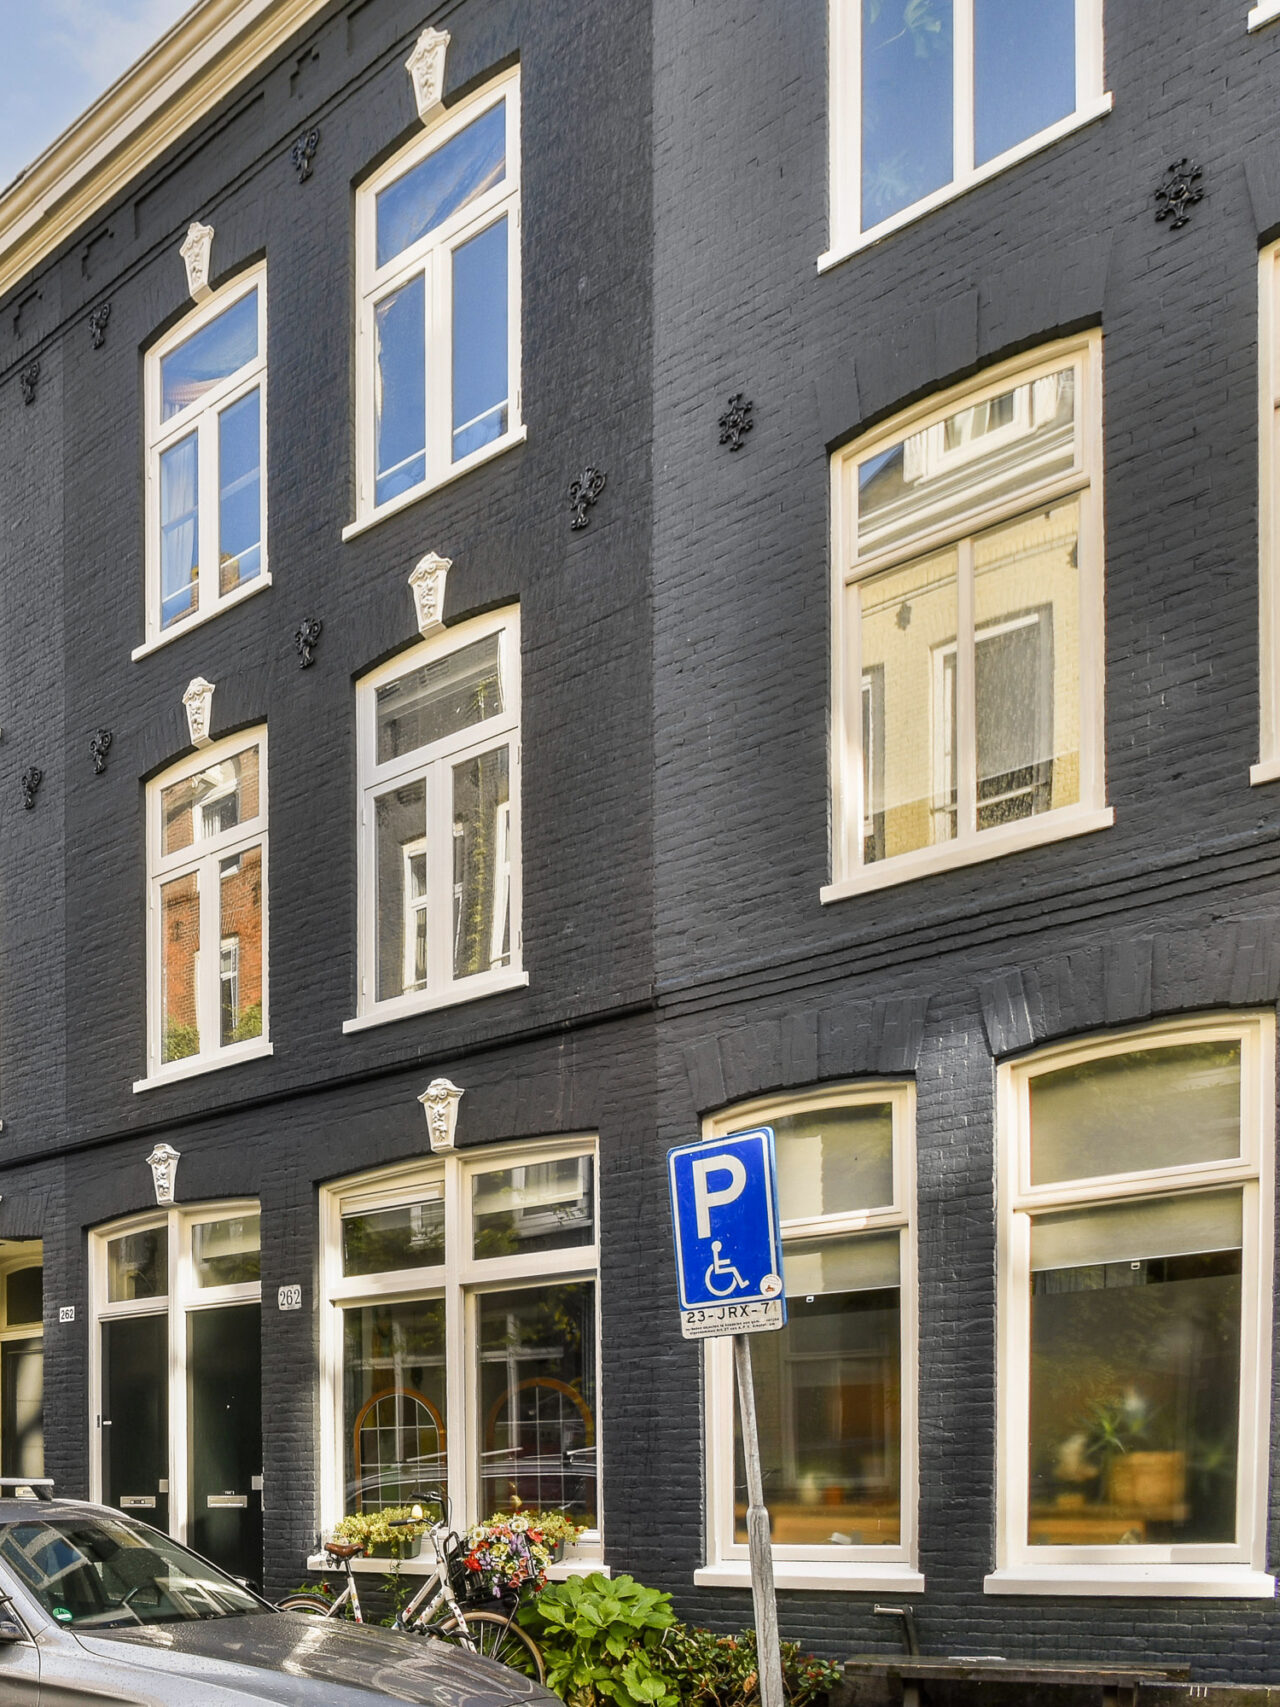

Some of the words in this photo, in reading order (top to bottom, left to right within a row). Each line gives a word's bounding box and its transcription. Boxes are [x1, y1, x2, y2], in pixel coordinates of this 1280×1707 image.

[692, 1154, 747, 1239] P
[279, 1288, 301, 1306] 262
[60, 1308, 74, 1320] 262
[686, 1303, 770, 1324] 23-JRX-7
